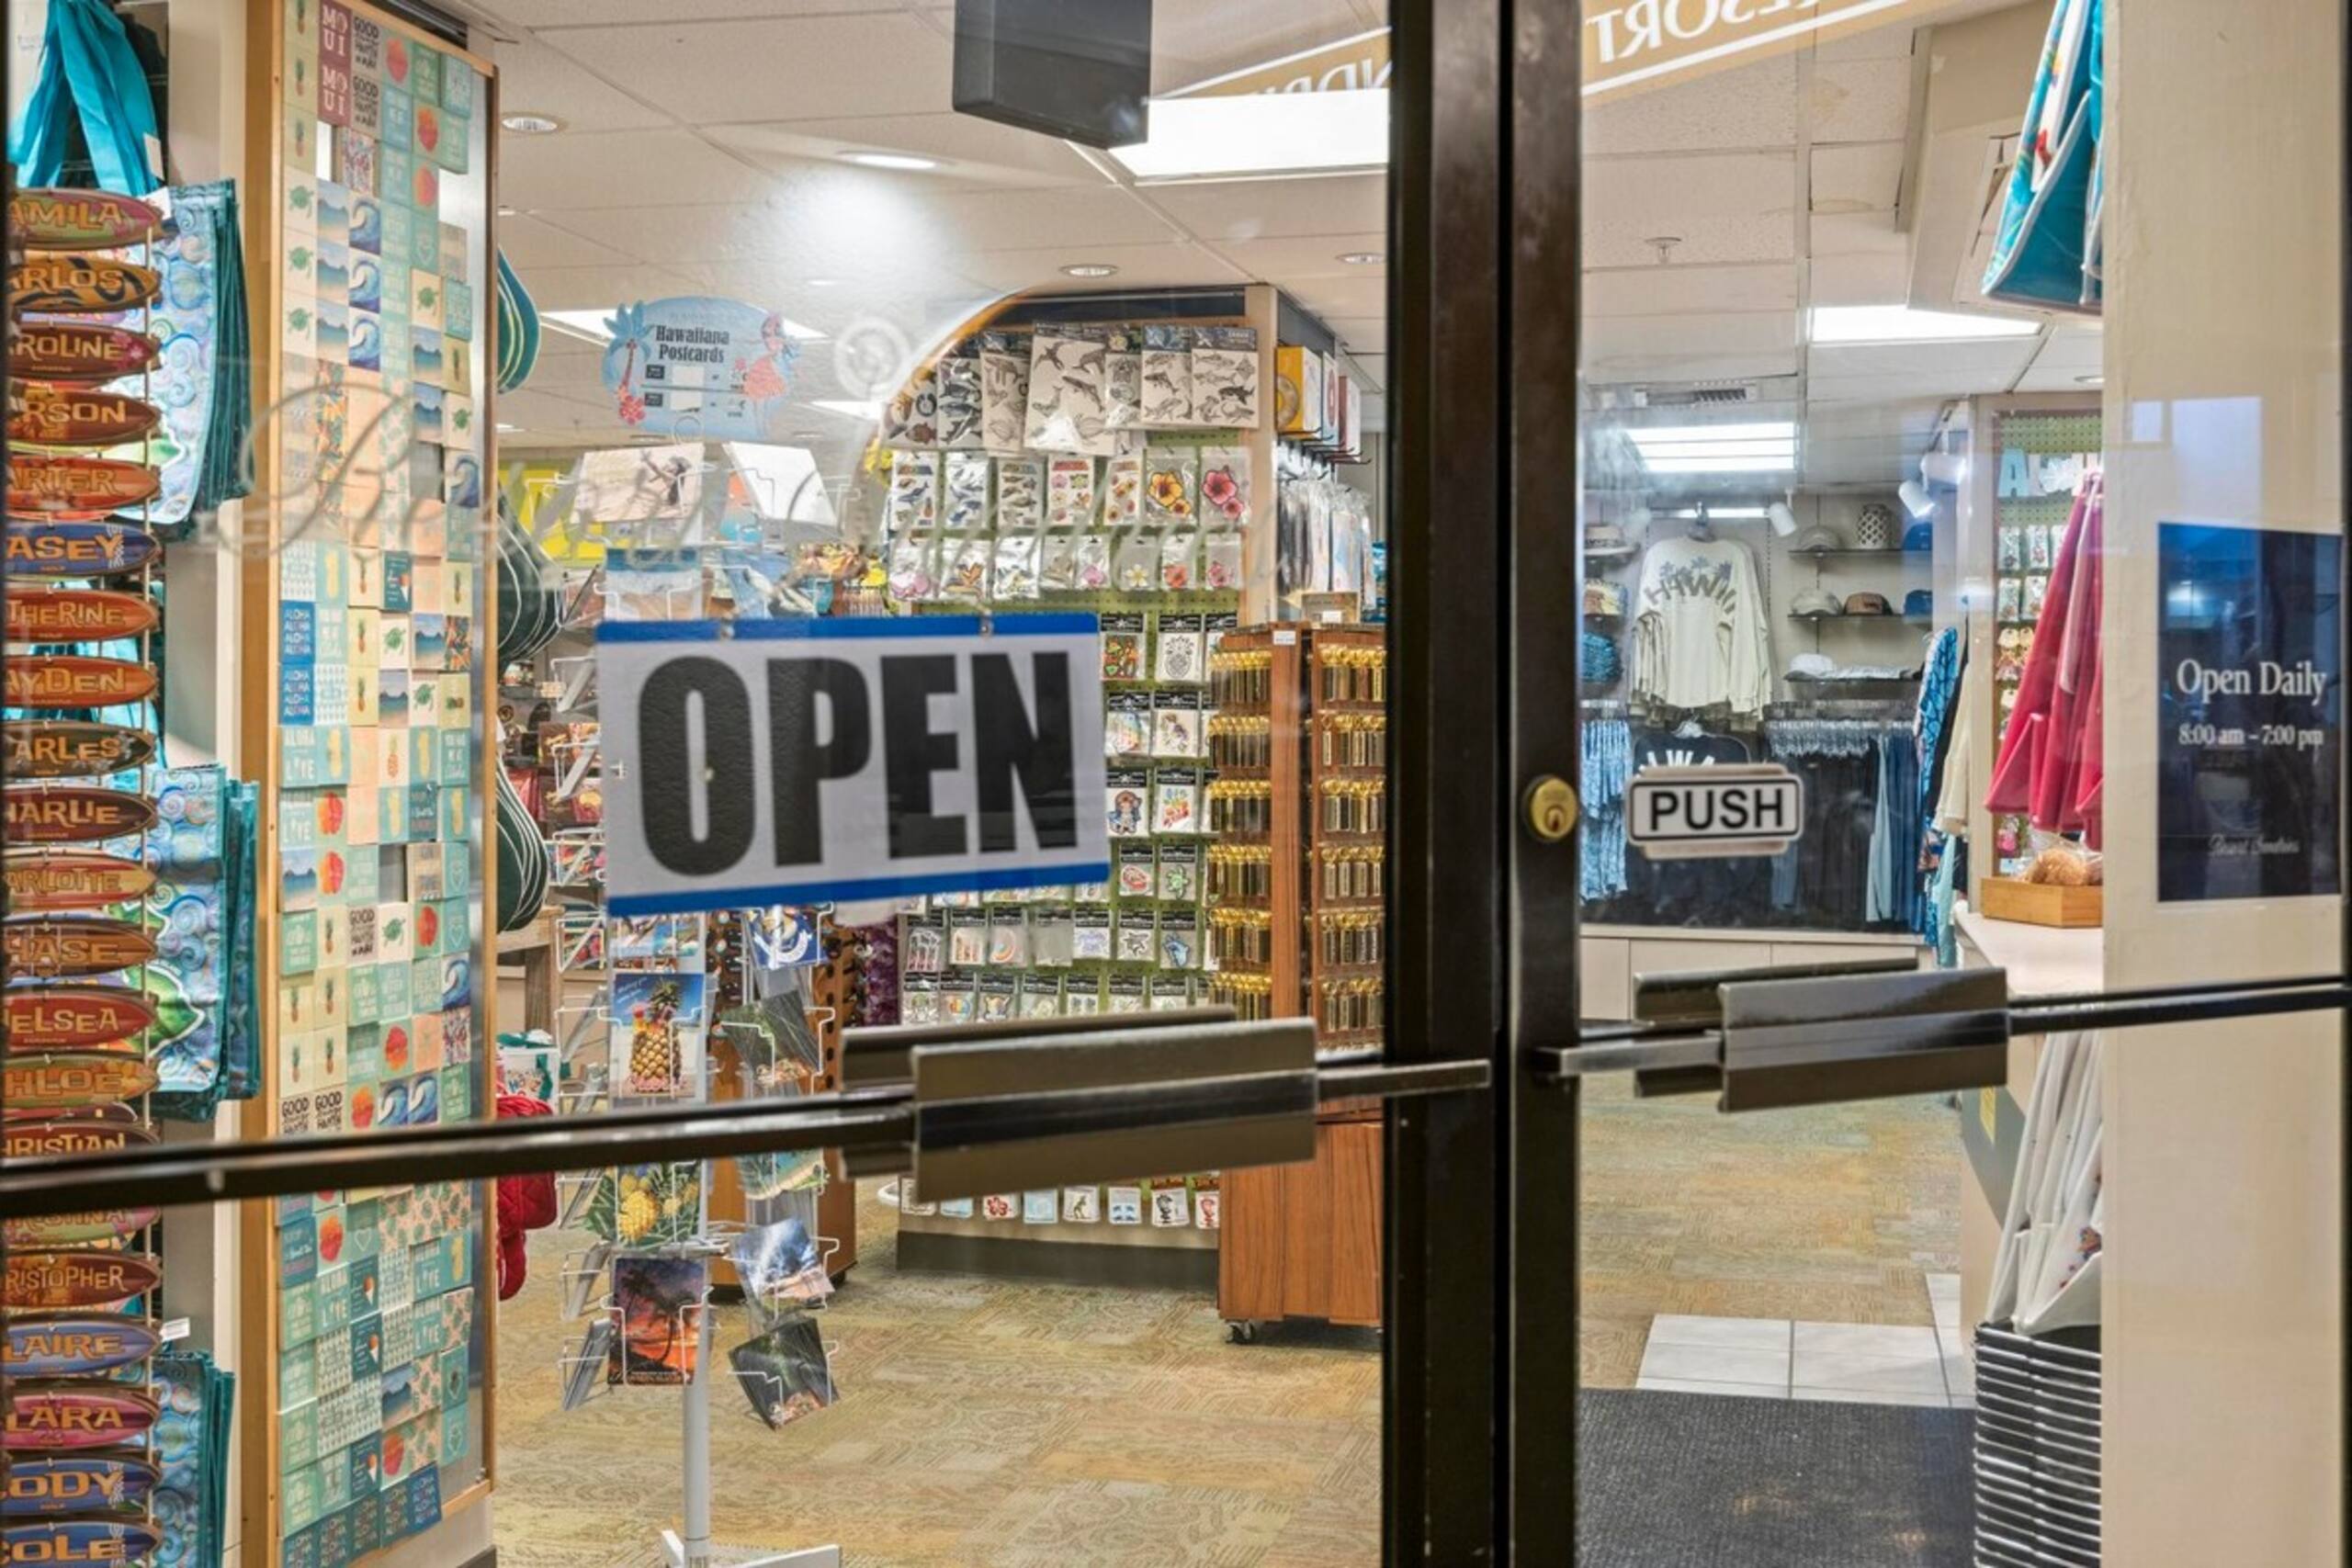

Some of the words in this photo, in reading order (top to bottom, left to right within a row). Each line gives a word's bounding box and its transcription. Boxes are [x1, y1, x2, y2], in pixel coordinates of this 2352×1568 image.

[8, 333, 125, 361] ROLINE
[656, 325, 730, 345] Hawaiiana
[658, 344, 725, 364] Postcards
[15, 400, 127, 424] RSON
[6, 534, 125, 562] ASEY
[6, 600, 126, 627] THERINE
[2177, 659, 2250, 705] Open
[2259, 660, 2327, 706] Daily
[2178, 722, 2215, 745] 8:00
[2218, 728, 2245, 745] am
[2262, 725, 2295, 746] 7:00
[2298, 729, 2324, 751] pm
[638, 651, 1079, 877] OPEN
[1650, 788, 1783, 831] PUSH
[4, 1068, 123, 1099] HLOE
[6, 1265, 128, 1292] RISTOPHER
[2, 1334, 124, 1361] LAIRE
[6, 1405, 124, 1434] LARA
[0, 1471, 123, 1500] ODY
